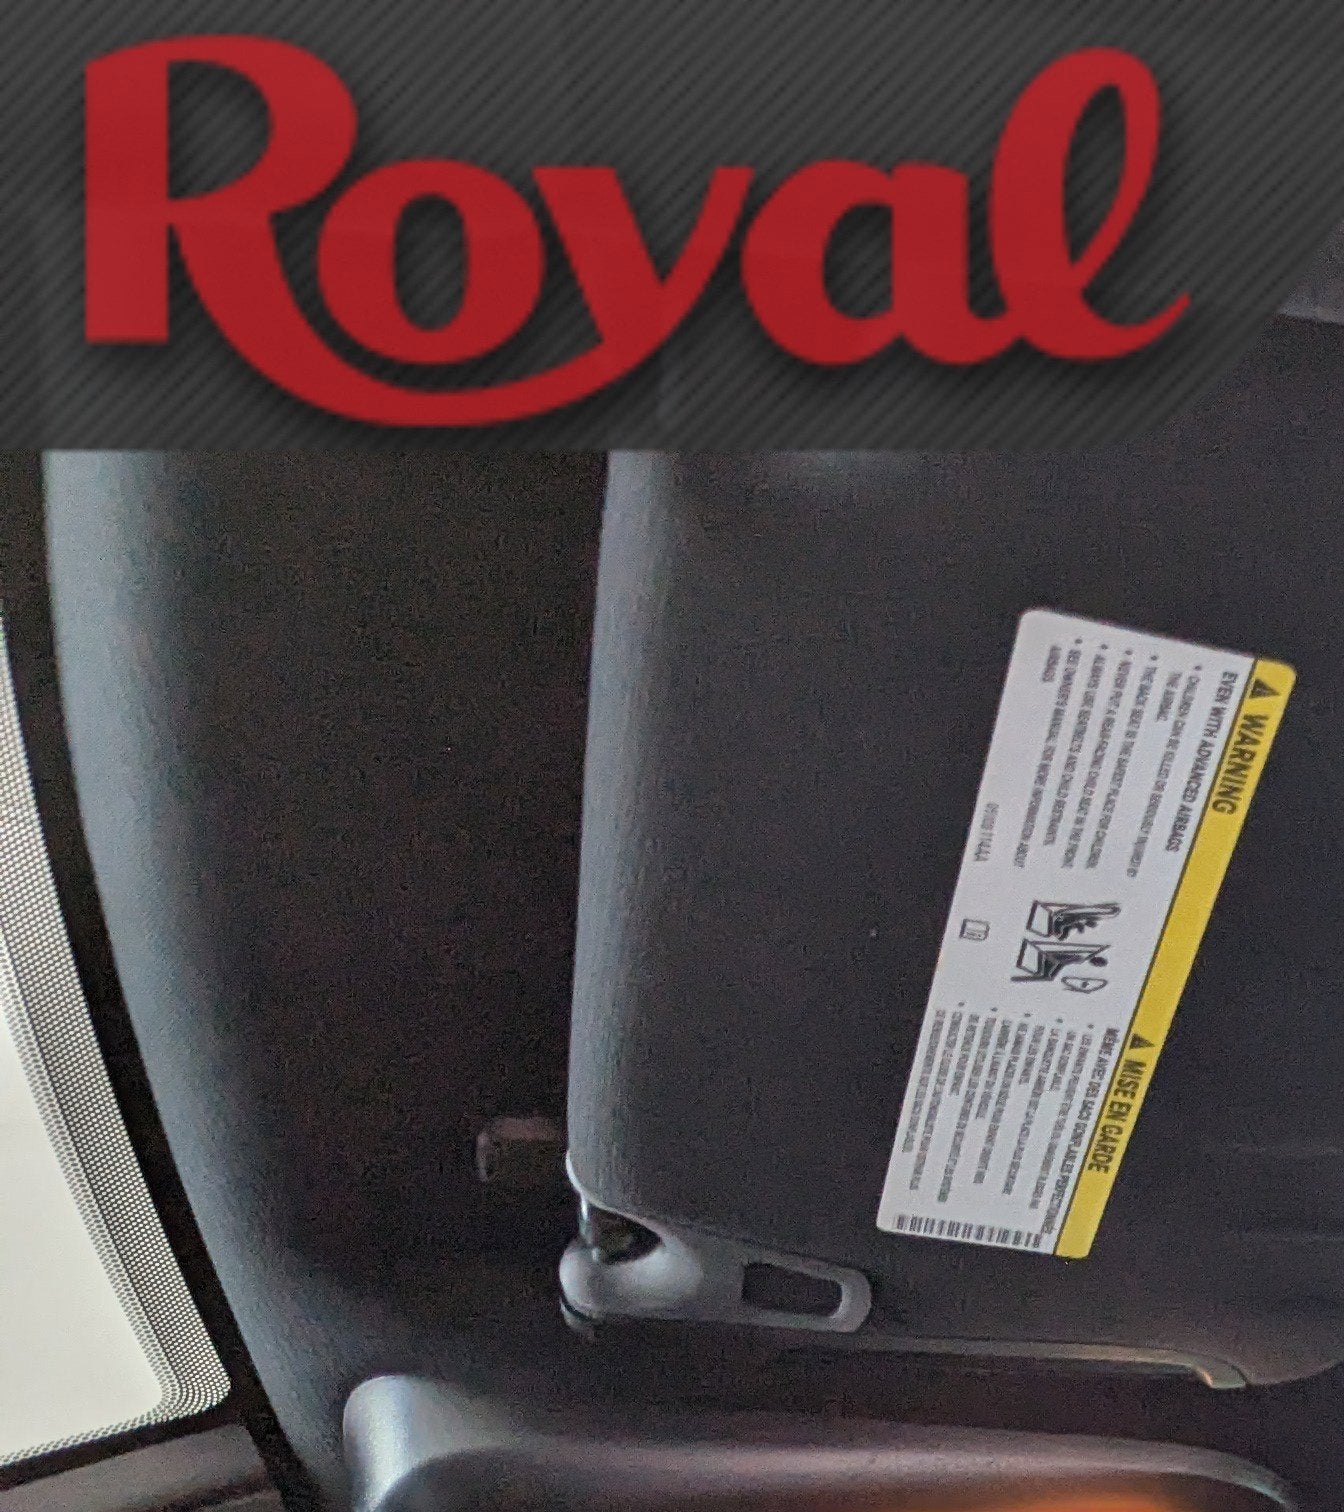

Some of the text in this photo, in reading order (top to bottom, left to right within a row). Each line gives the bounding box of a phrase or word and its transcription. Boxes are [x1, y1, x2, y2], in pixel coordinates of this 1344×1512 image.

[1210, 711, 1269, 816] WARNING
[1087, 1059, 1146, 1173] MISE EN GARDE
